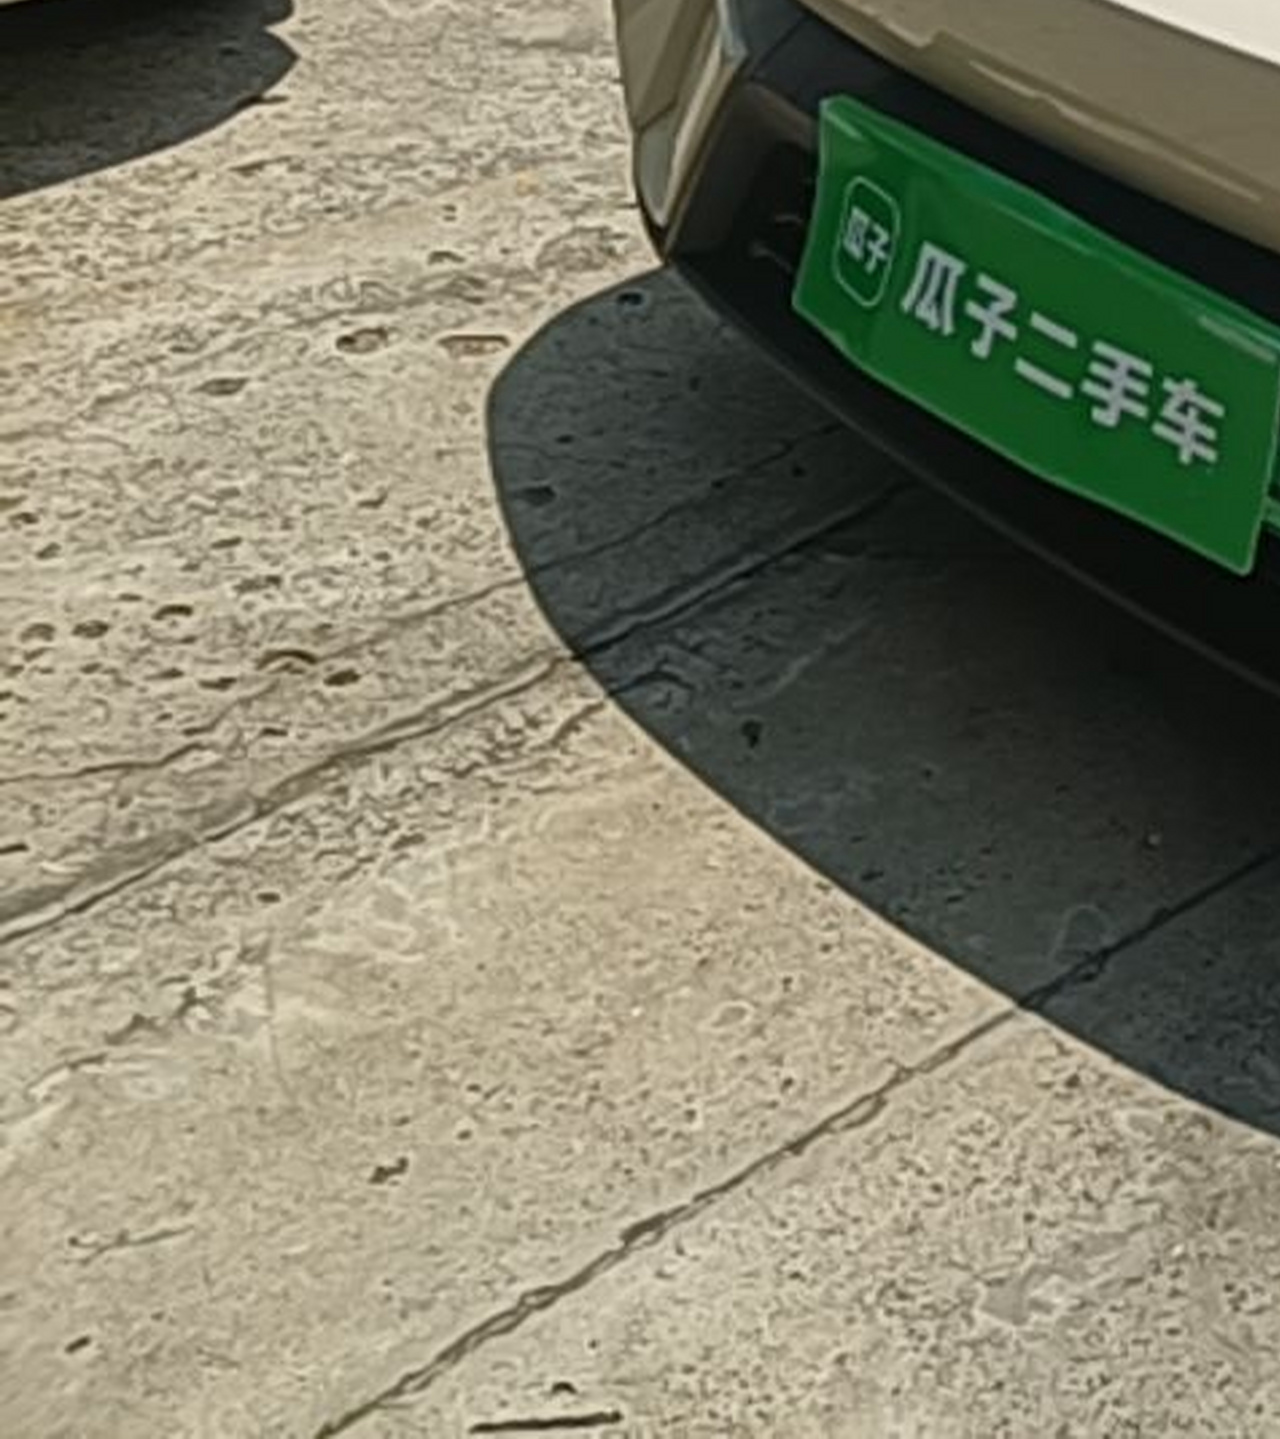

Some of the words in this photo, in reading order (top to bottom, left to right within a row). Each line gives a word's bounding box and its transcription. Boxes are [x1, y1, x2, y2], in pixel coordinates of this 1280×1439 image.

[901, 241, 1226, 466] 瓜子二手车
